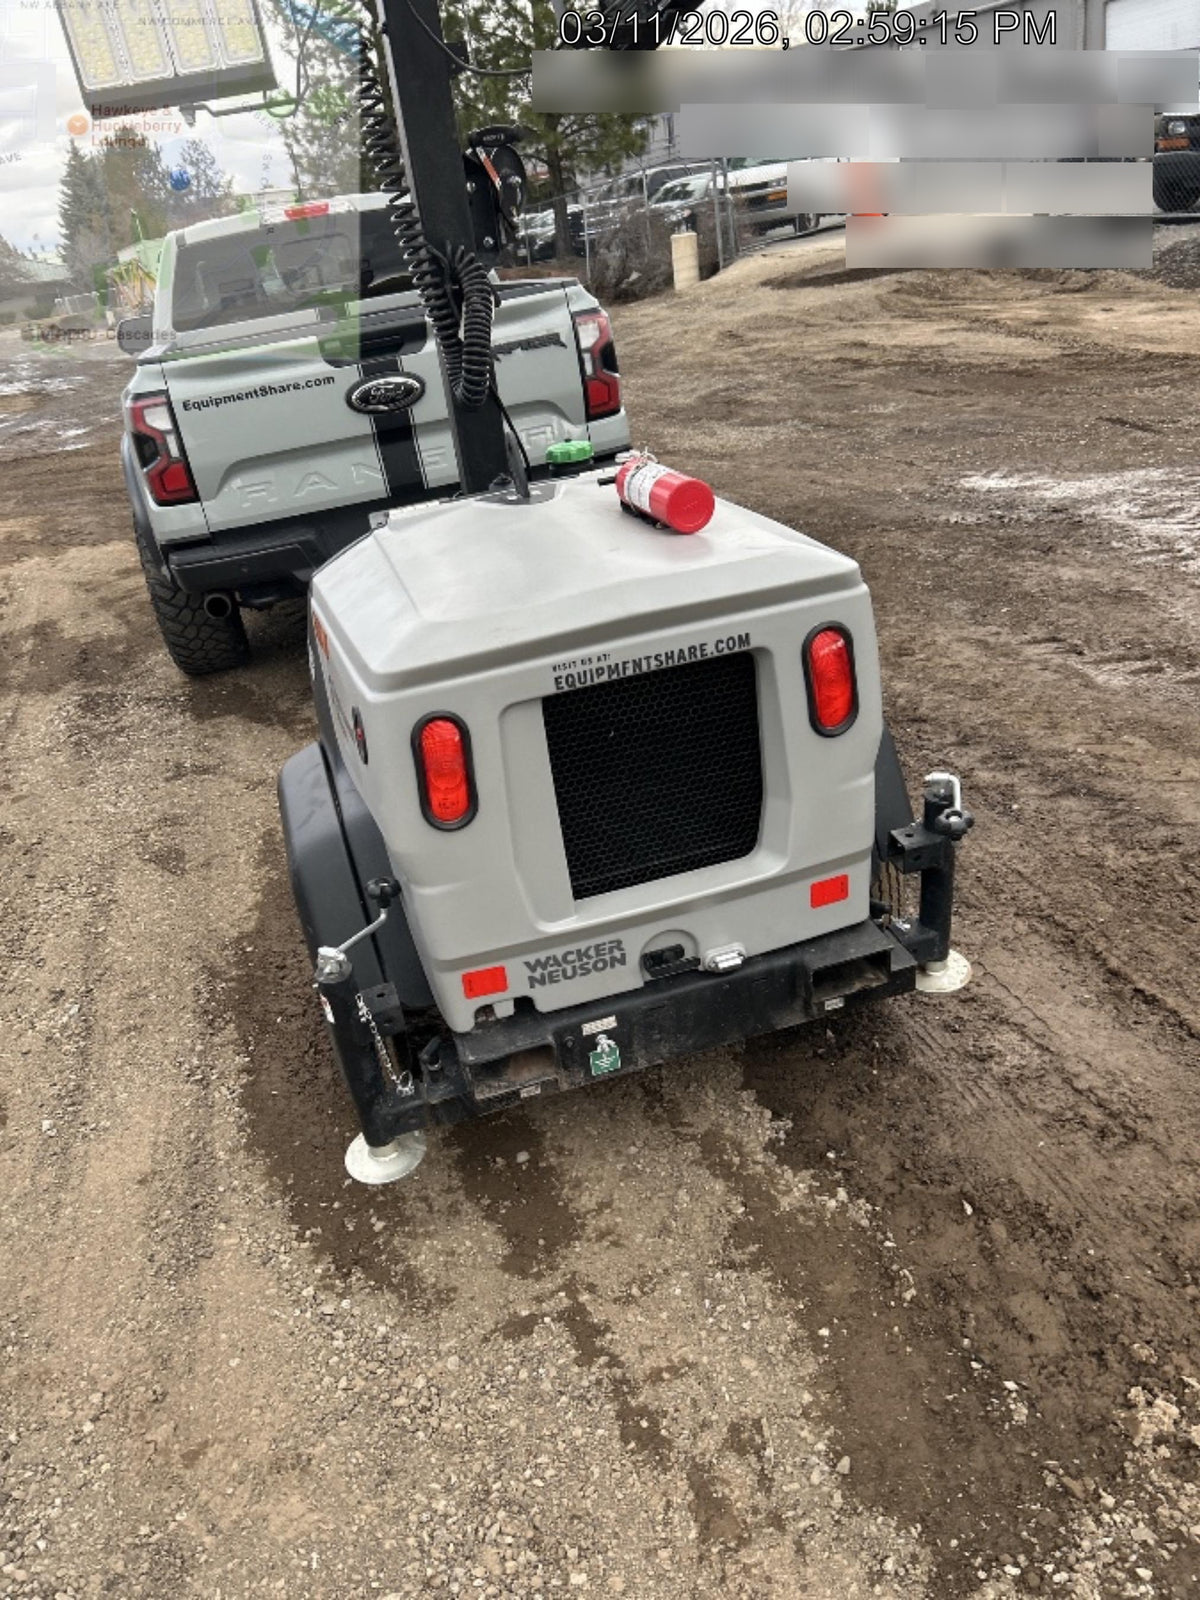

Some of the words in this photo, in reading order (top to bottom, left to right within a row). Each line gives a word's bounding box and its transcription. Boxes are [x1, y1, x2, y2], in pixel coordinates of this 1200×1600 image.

[182, 376, 336, 413] EquipmentShare.com
[553, 632, 752, 691] EQUIPMENTSHARE.COM
[523, 939, 626, 971] WACKER
[528, 952, 627, 988] NEUSON
